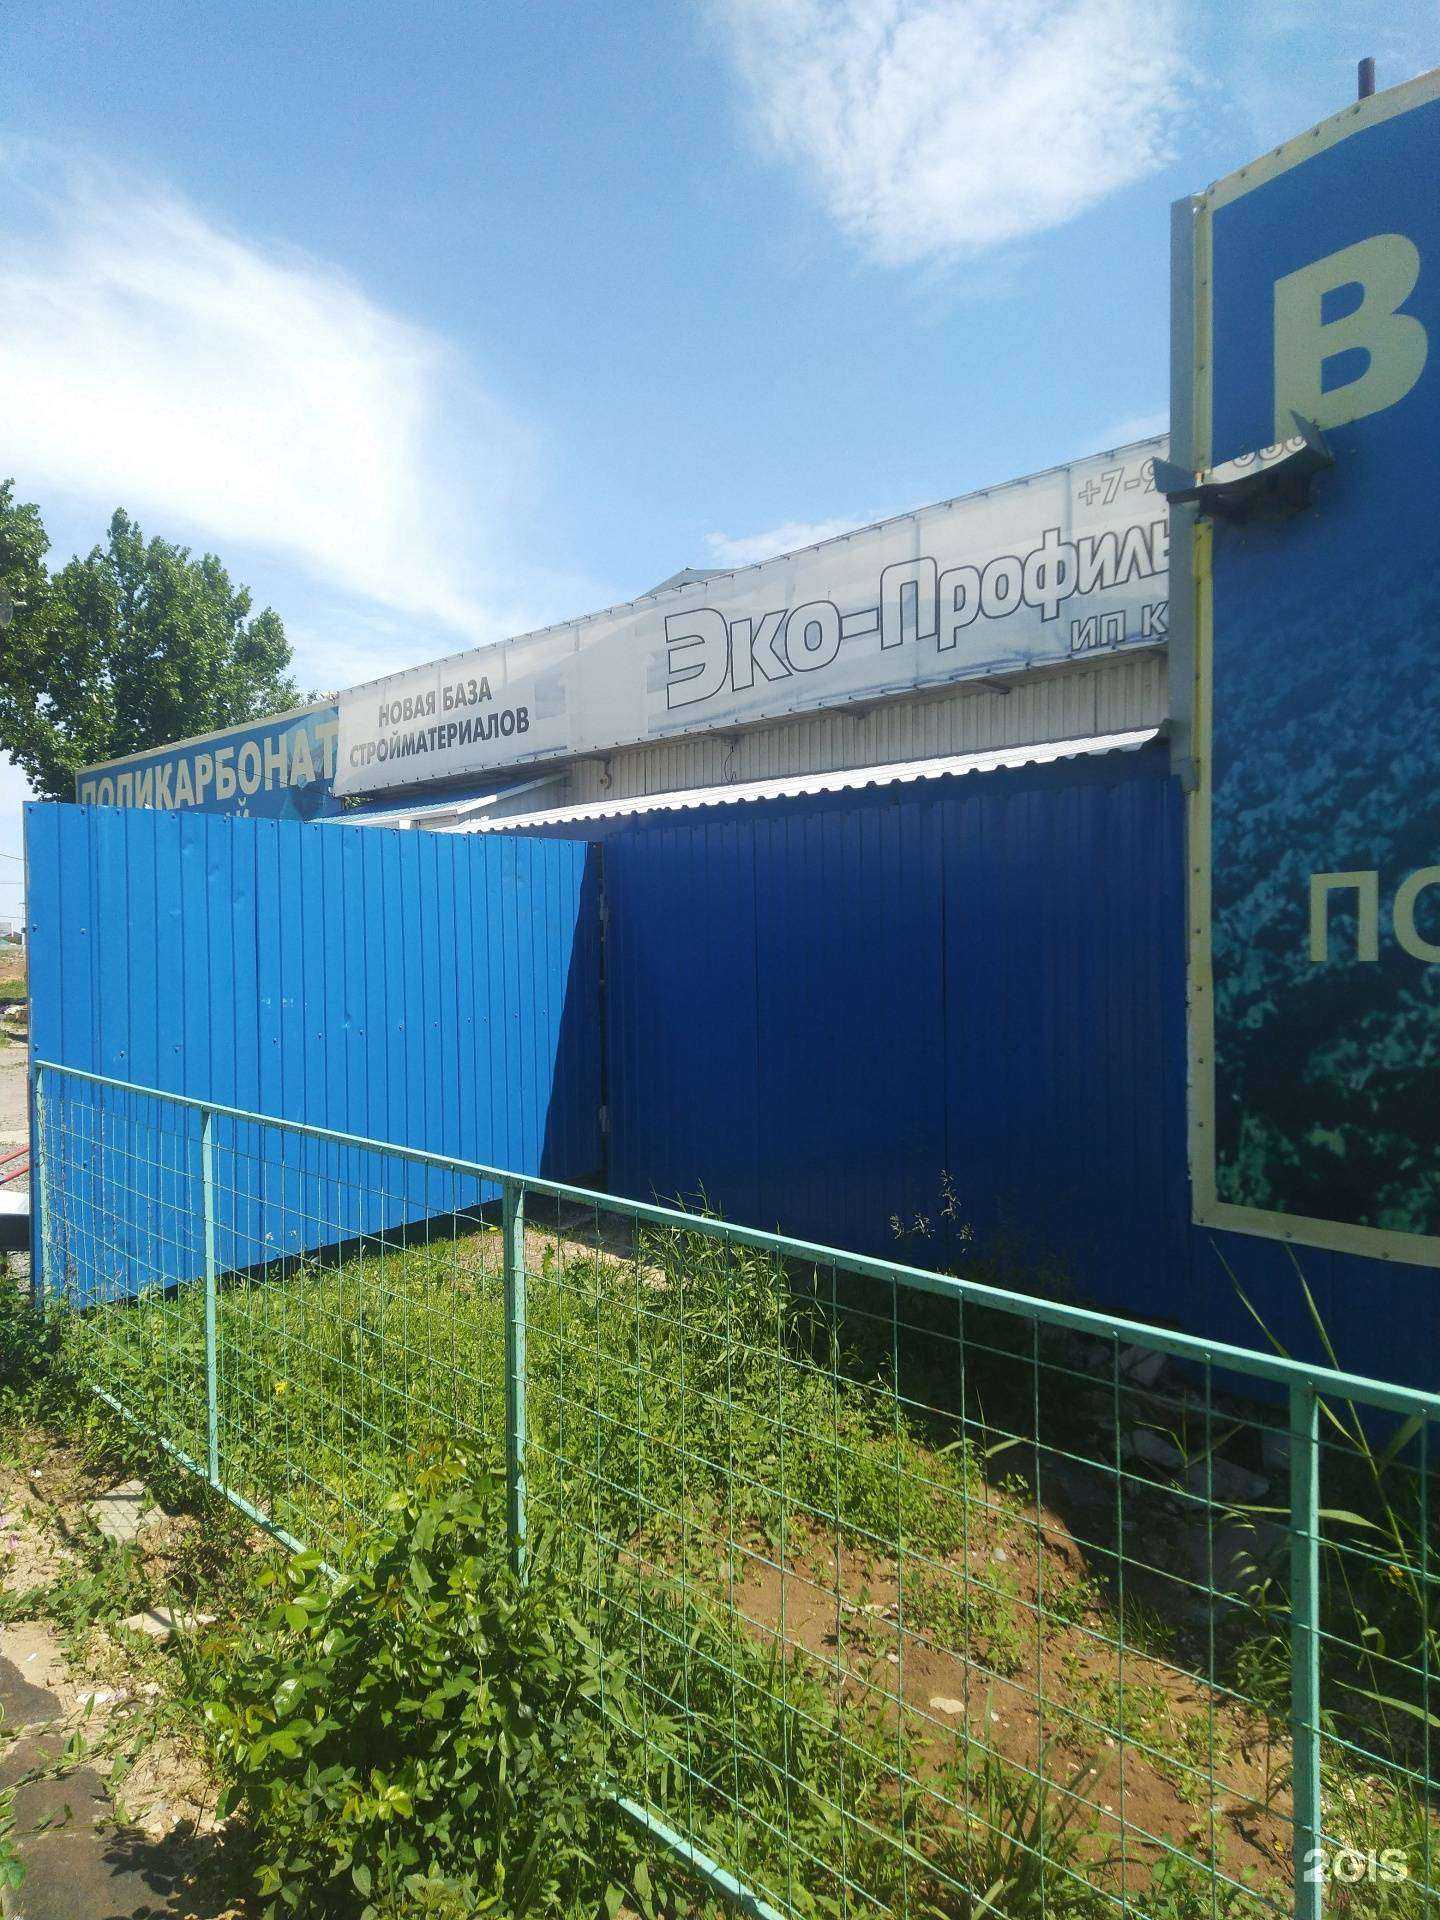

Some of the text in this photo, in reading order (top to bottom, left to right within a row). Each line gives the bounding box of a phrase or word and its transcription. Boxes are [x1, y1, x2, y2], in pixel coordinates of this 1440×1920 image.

[1274, 233, 1429, 444] В
[1071, 610, 1127, 651] ИП
[379, 676, 493, 728] НОВАЯ БАЗА
[350, 706, 530, 768] СТРОЙМАТЕРИАЛОВ
